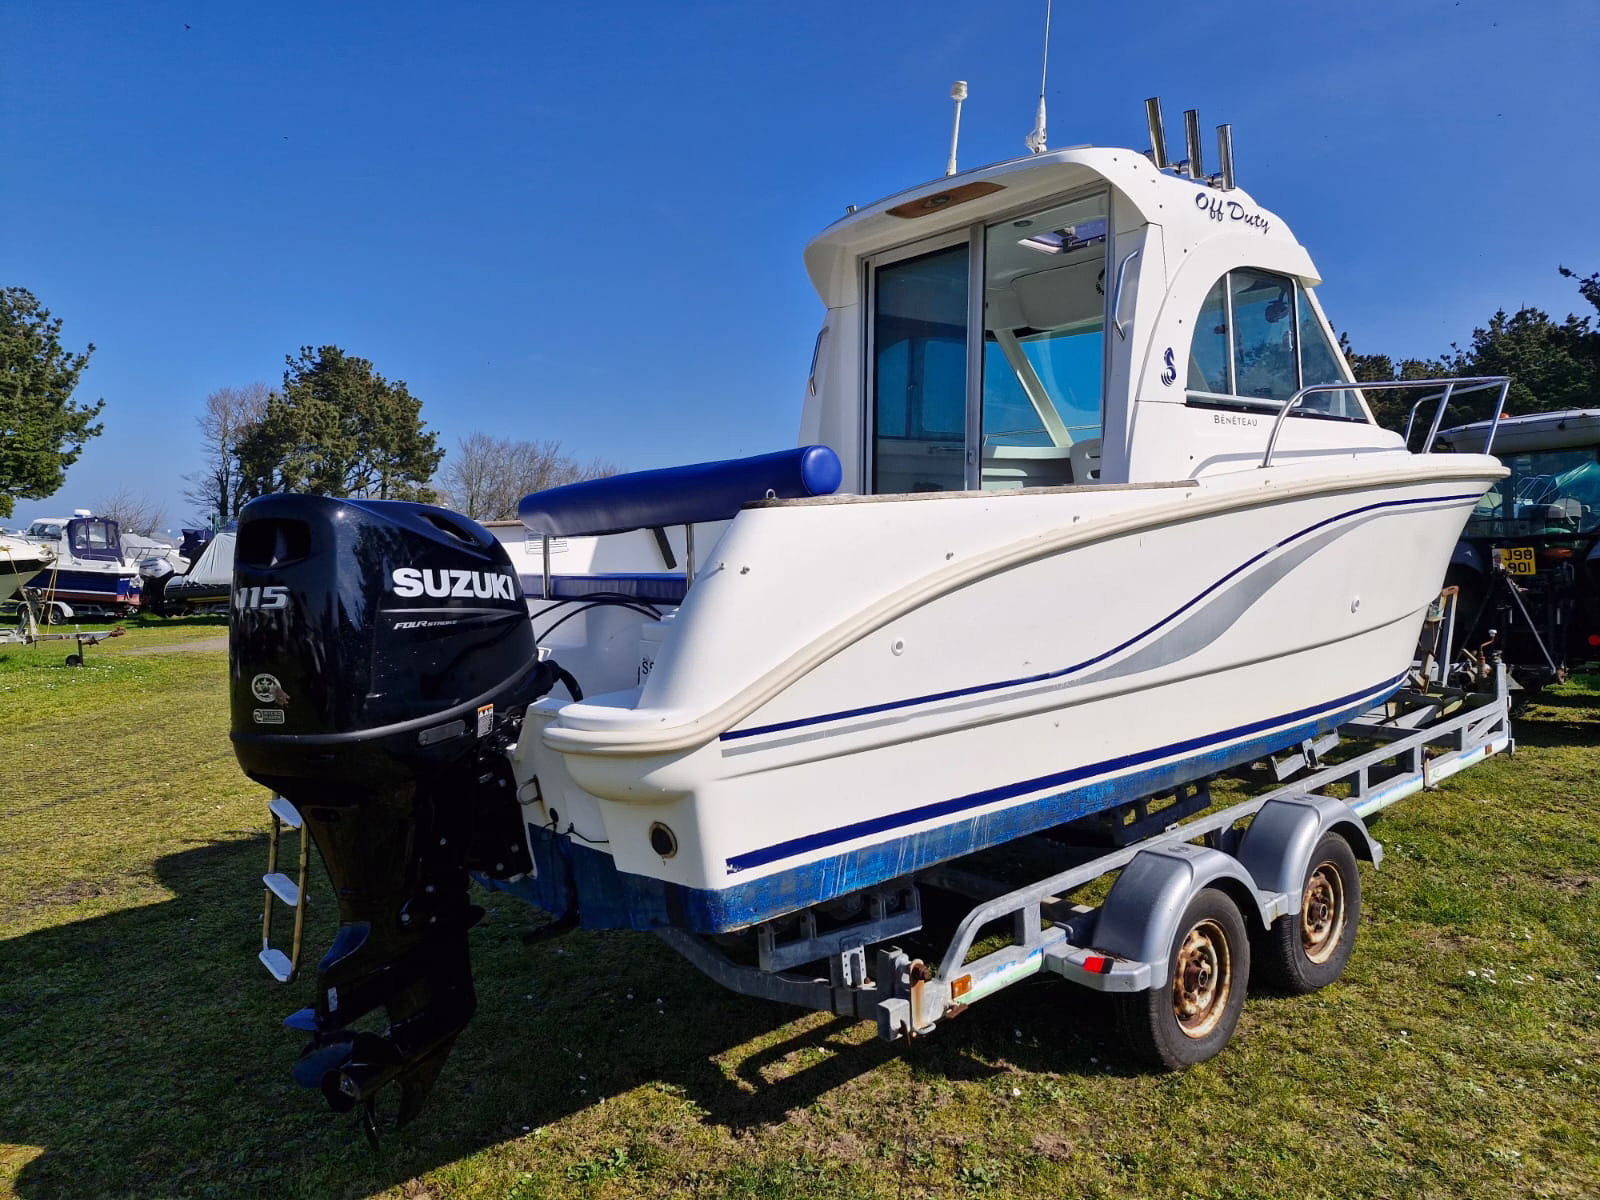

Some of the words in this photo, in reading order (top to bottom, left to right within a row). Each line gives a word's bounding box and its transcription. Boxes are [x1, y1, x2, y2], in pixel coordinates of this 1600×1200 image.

[1195, 192, 1224, 222] Off
[1227, 201, 1270, 234] Duty
[1503, 549, 1533, 561] J98
[392, 567, 516, 601] SUZUKI
[239, 586, 289, 609] 115
[393, 620, 428, 631] FOUR
